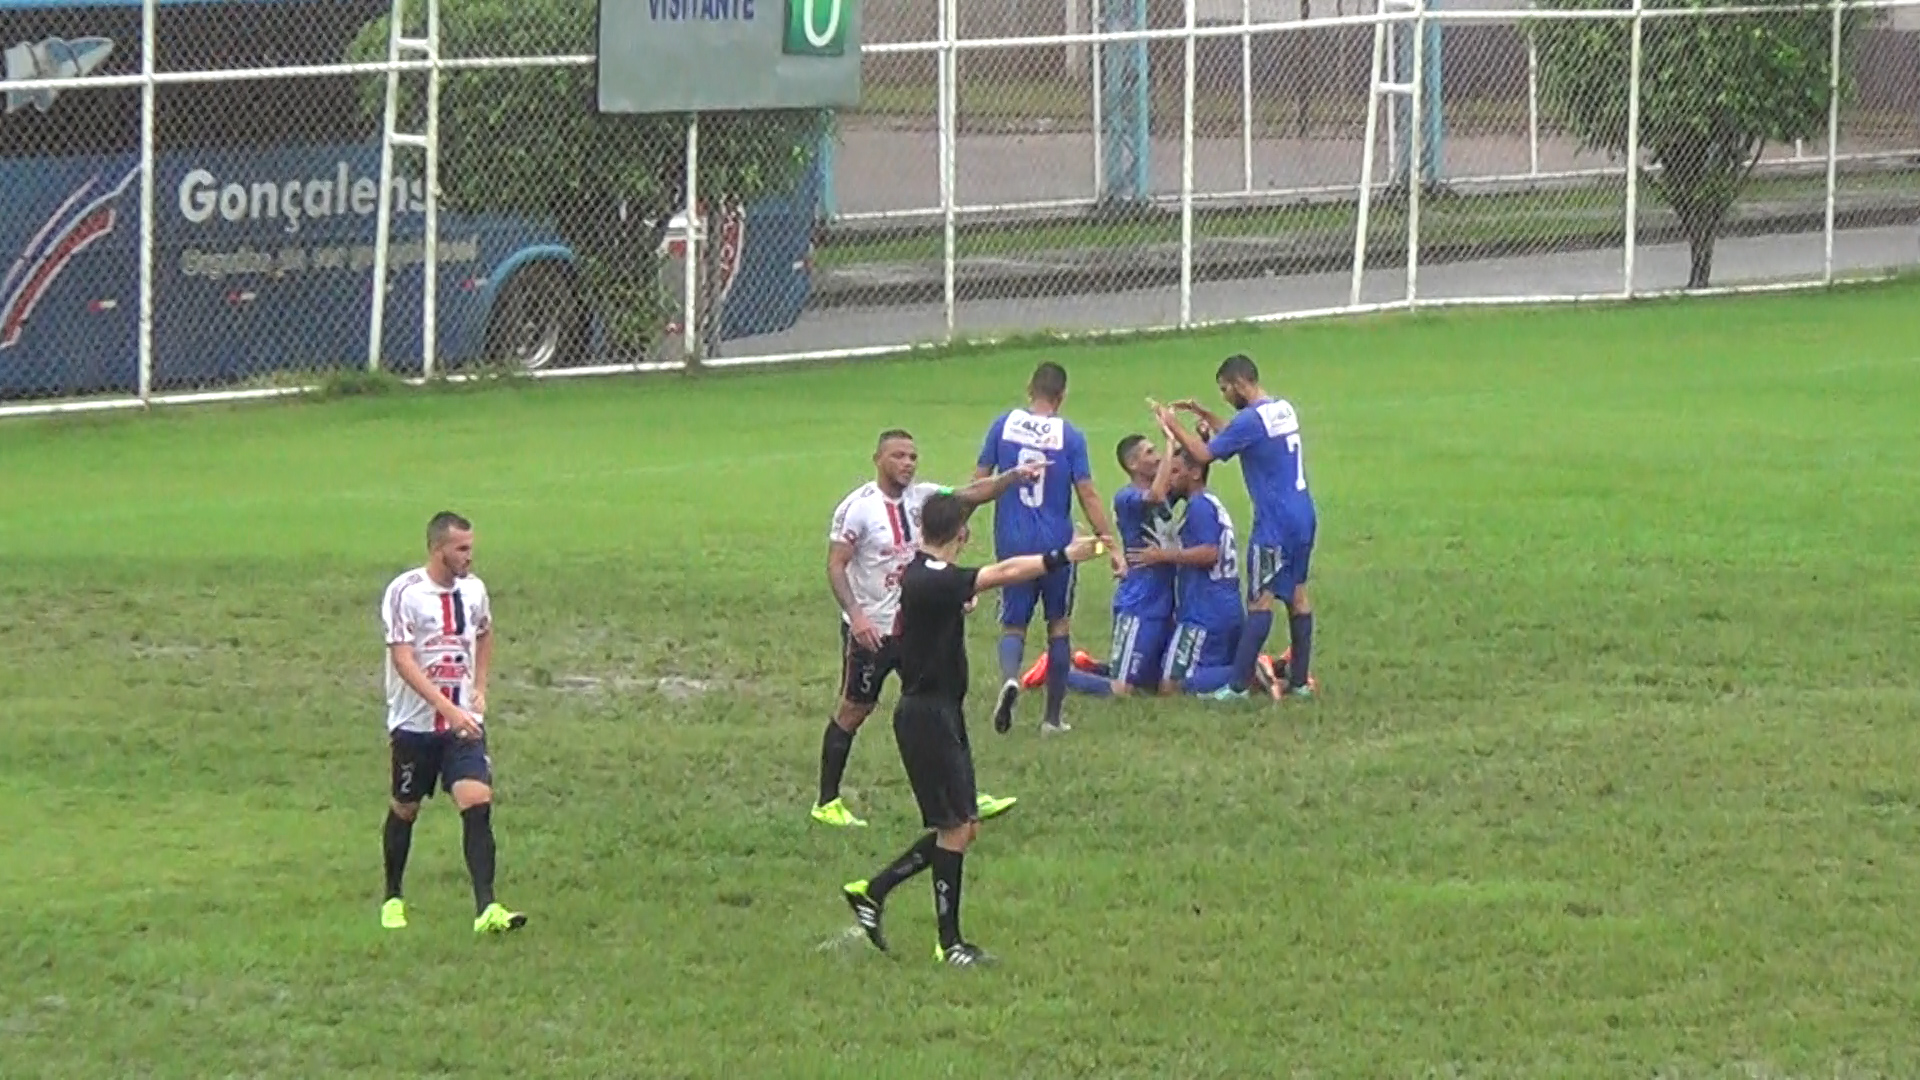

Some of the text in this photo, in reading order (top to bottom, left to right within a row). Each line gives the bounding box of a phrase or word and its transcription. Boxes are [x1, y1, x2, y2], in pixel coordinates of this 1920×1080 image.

[649, 0, 755, 20] VISITANTE
[1018, 448, 1046, 508] 9
[1286, 433, 1306, 492] 7
[1208, 528, 1239, 581] 15
[860, 672, 872, 694] 5
[401, 771, 413, 793] 2
